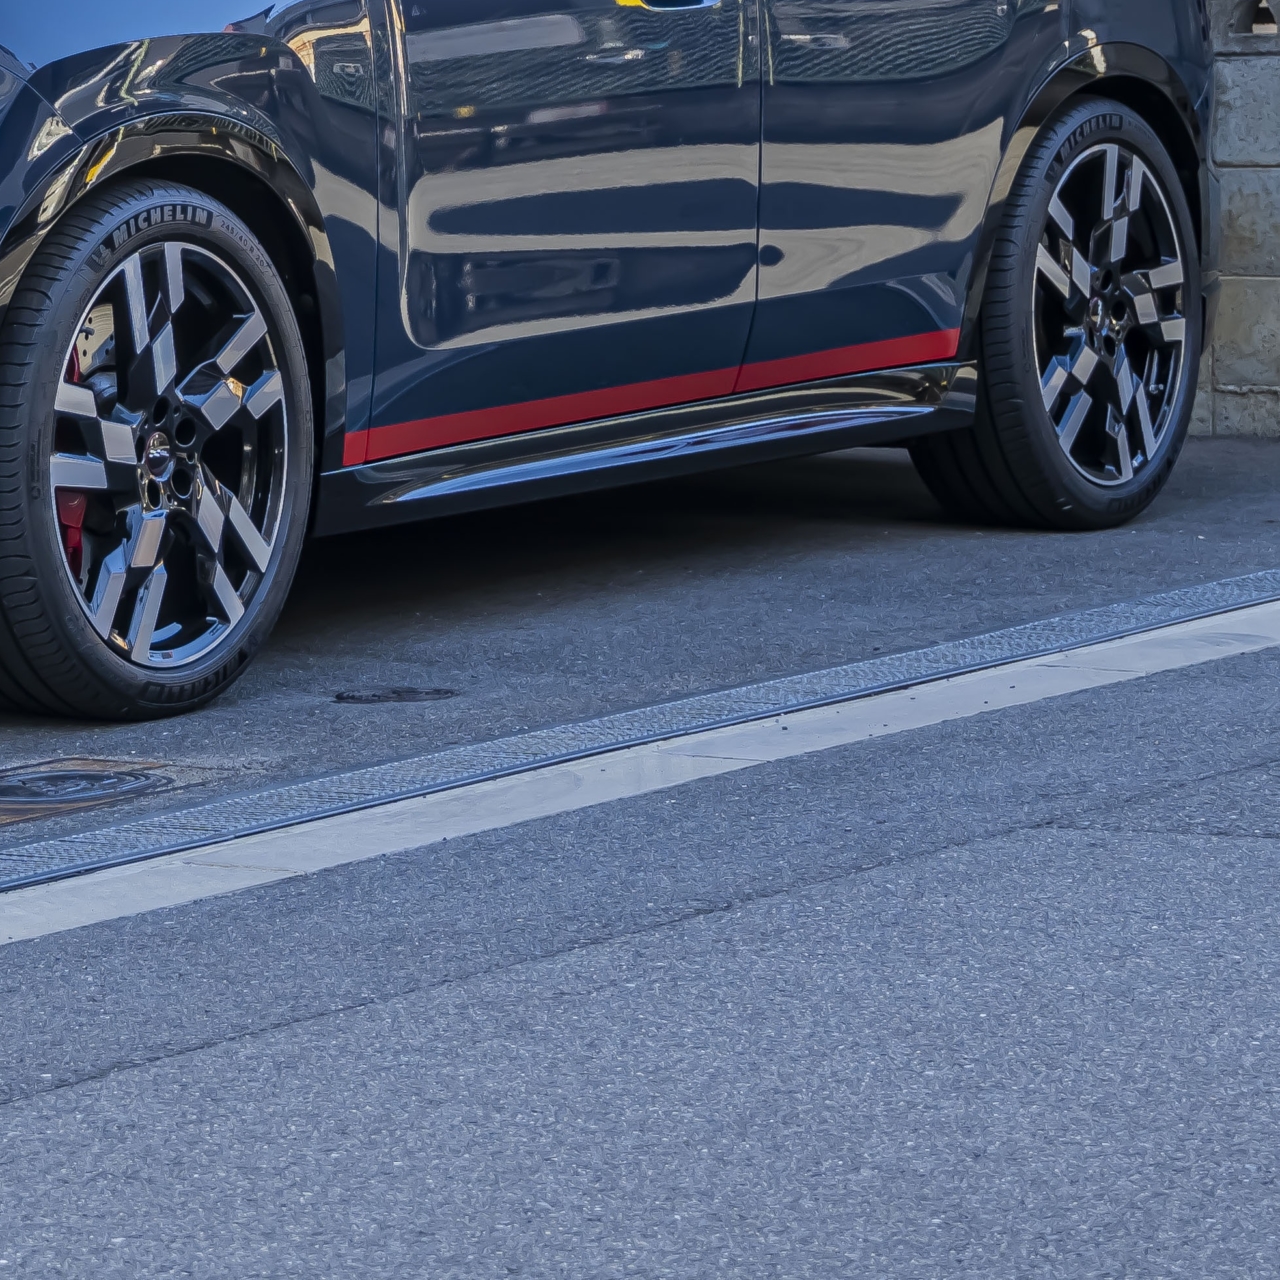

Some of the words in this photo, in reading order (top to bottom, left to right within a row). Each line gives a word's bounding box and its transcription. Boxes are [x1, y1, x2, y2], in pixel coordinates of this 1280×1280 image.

[1061, 114, 1120, 161] MICHELIN
[112, 205, 208, 249] MICHELIN
[220, 220, 248, 247] 245/40
[249, 246, 255, 254] R
[255, 255, 265, 267] 20
